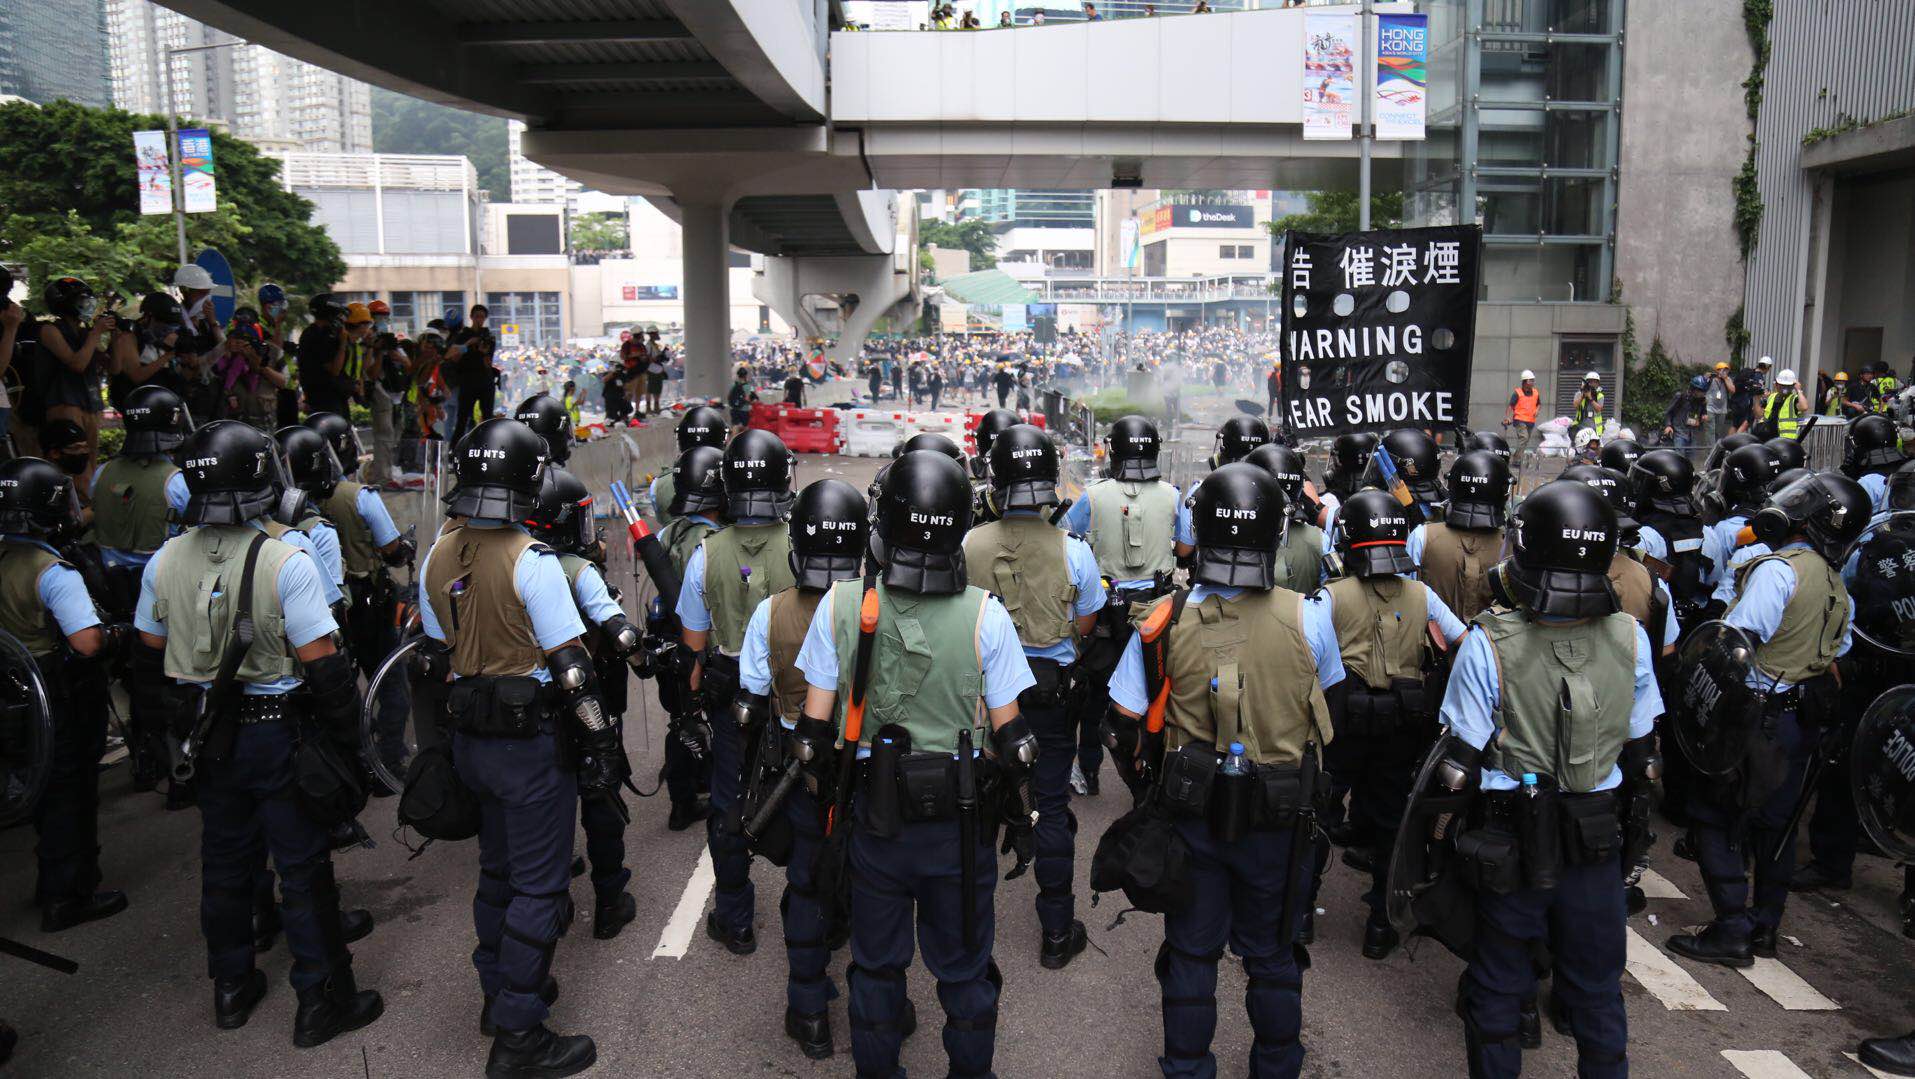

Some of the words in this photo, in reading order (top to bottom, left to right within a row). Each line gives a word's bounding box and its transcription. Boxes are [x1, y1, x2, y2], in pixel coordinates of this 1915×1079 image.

[1381, 28, 1425, 41] HONG
[1381, 40, 1424, 52] KONG
[1203, 212, 1236, 222] theDesk
[1291, 246, 1313, 290] 告
[1340, 241, 1461, 289] 催淚煙
[1288, 396, 1335, 429] EAR
[1346, 391, 1453, 425] SMOKE
[468, 449, 481, 458] EU
[483, 449, 506, 460] NTS
[1012, 450, 1025, 459] EU
[1025, 448, 1043, 458] NTS
[185, 459, 196, 469] EU
[197, 457, 218, 467] NTS
[481, 462, 488, 472] 3
[733, 460, 745, 469] EU
[747, 459, 766, 468] NTS
[1025, 460, 1032, 469] 3
[198, 470, 205, 479] 3
[746, 471, 753, 479] 3
[1277, 472, 1288, 480] EU
[1288, 473, 1301, 481] NTS
[1460, 475, 1471, 483] EU
[1472, 476, 1488, 484] NTS
[1286, 483, 1292, 491] 3
[1587, 479, 1600, 487] EU
[1601, 478, 1617, 487] NTS
[1470, 486, 1476, 494] 3
[1602, 489, 1609, 497] 3
[1215, 507, 1231, 518] EU
[1233, 509, 1257, 520] NTS
[910, 512, 927, 524] EU
[930, 515, 954, 526] NTS
[1379, 517, 1392, 525] EU
[1392, 517, 1406, 525] NTS
[822, 520, 837, 530] EU
[838, 521, 857, 531] NTS
[1231, 525, 1239, 535] 3
[836, 535, 843, 544] 3
[923, 531, 931, 540] 3
[1562, 528, 1581, 540] EU
[1583, 530, 1606, 542] NTS
[1578, 546, 1587, 557] 3
